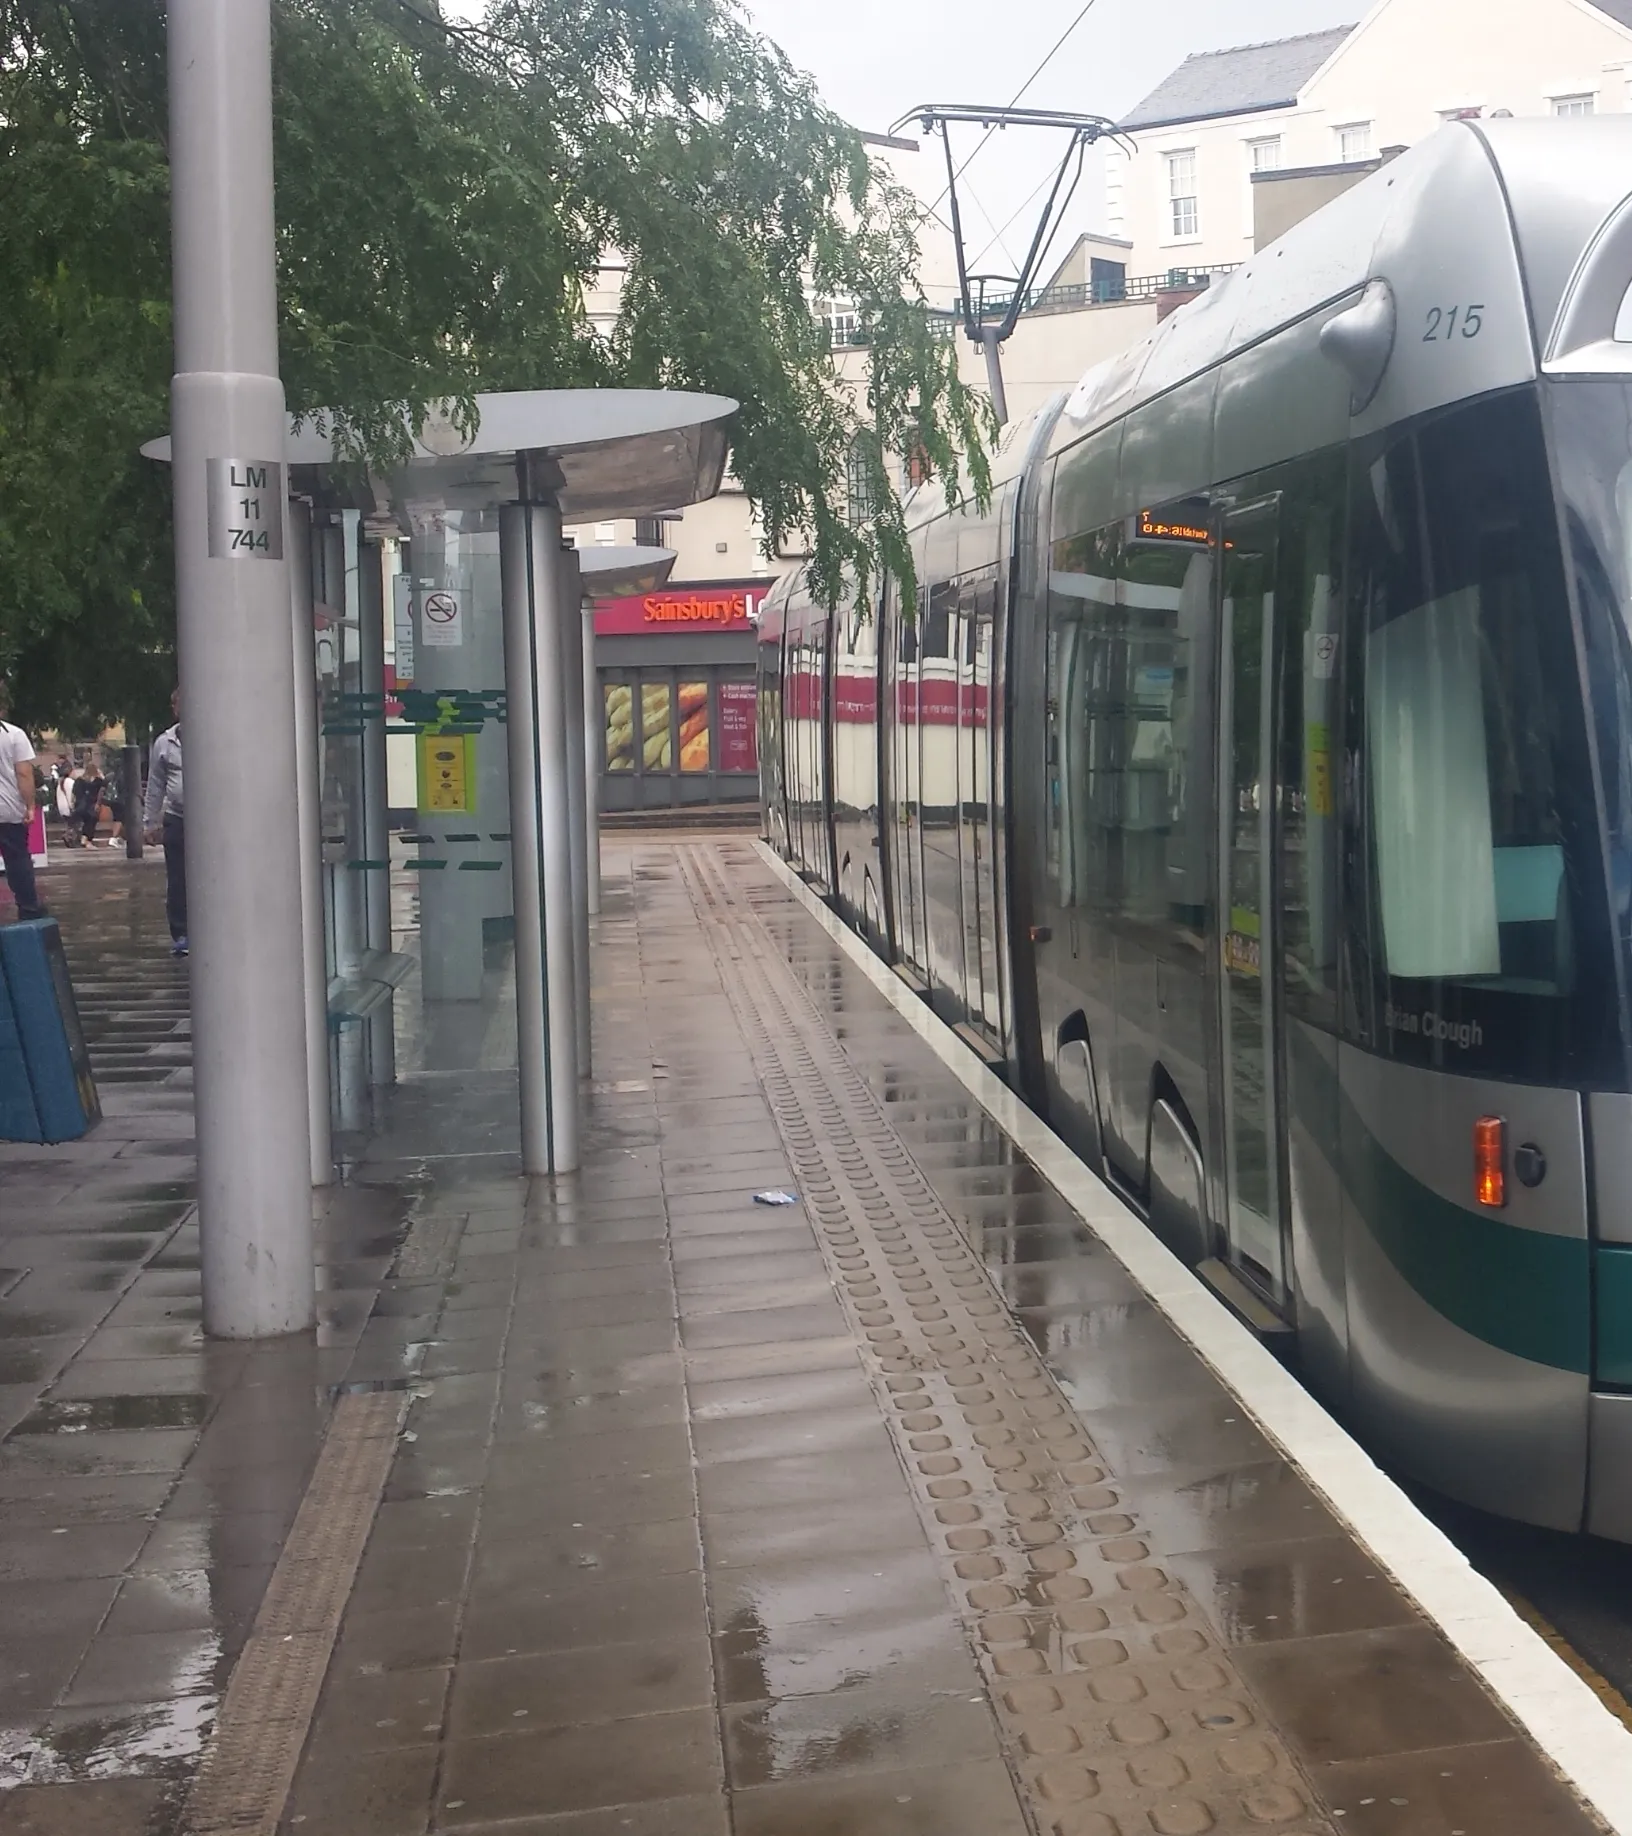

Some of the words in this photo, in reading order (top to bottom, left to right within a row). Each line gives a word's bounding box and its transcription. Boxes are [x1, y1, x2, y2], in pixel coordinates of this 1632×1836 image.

[1423, 304, 1485, 342] 215
[230, 466, 266, 488] LM
[240, 498, 260, 520] 11
[228, 528, 269, 551] 744
[643, 594, 745, 624] Sainsbury's
[1422, 1011, 1483, 1050] Clough
